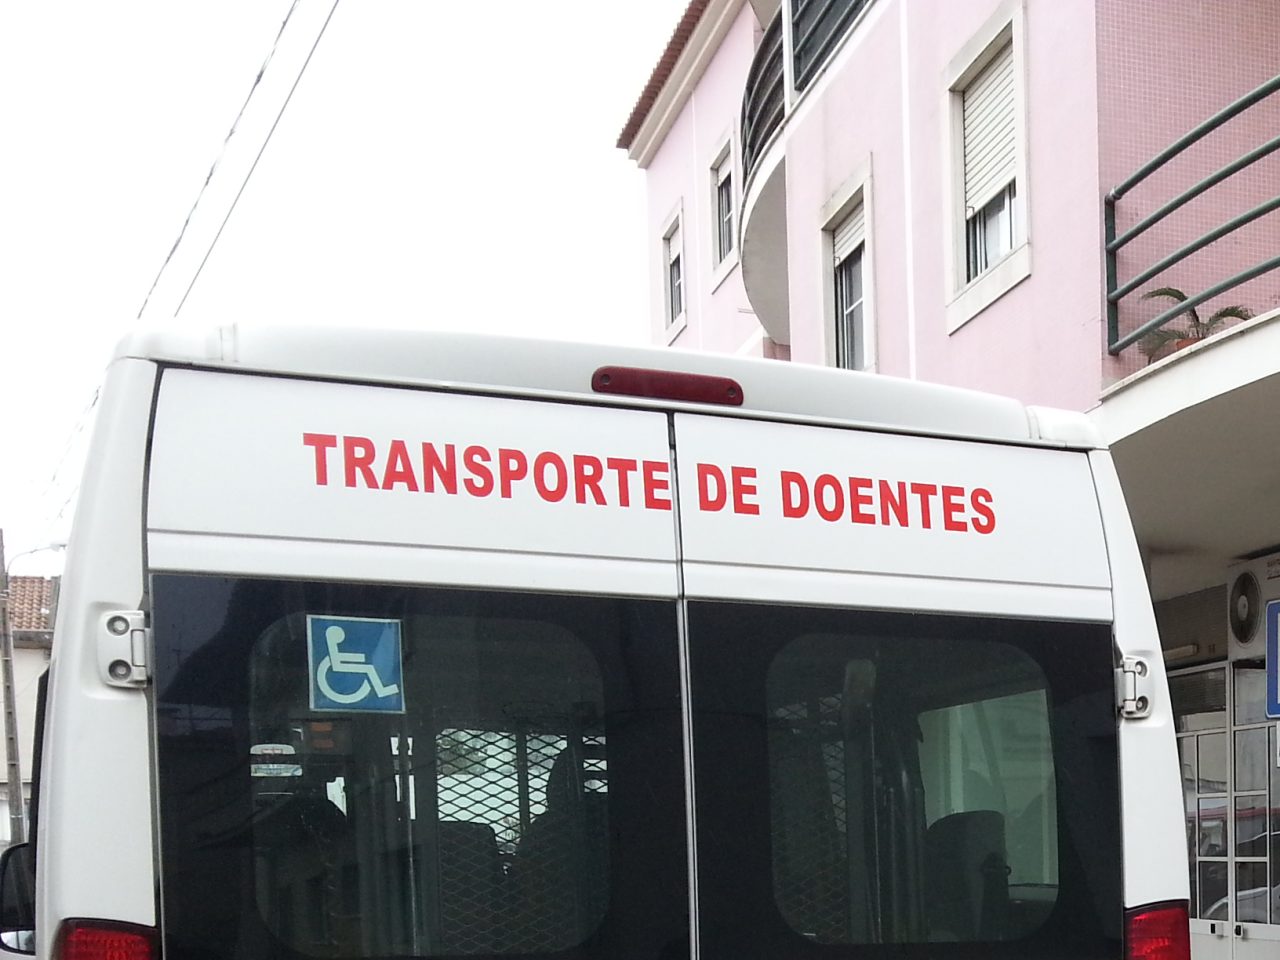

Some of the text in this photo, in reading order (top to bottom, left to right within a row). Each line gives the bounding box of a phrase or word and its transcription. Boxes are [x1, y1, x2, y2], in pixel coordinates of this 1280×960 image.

[303, 432, 996, 535] TRANSPORTE DE DOENTES
